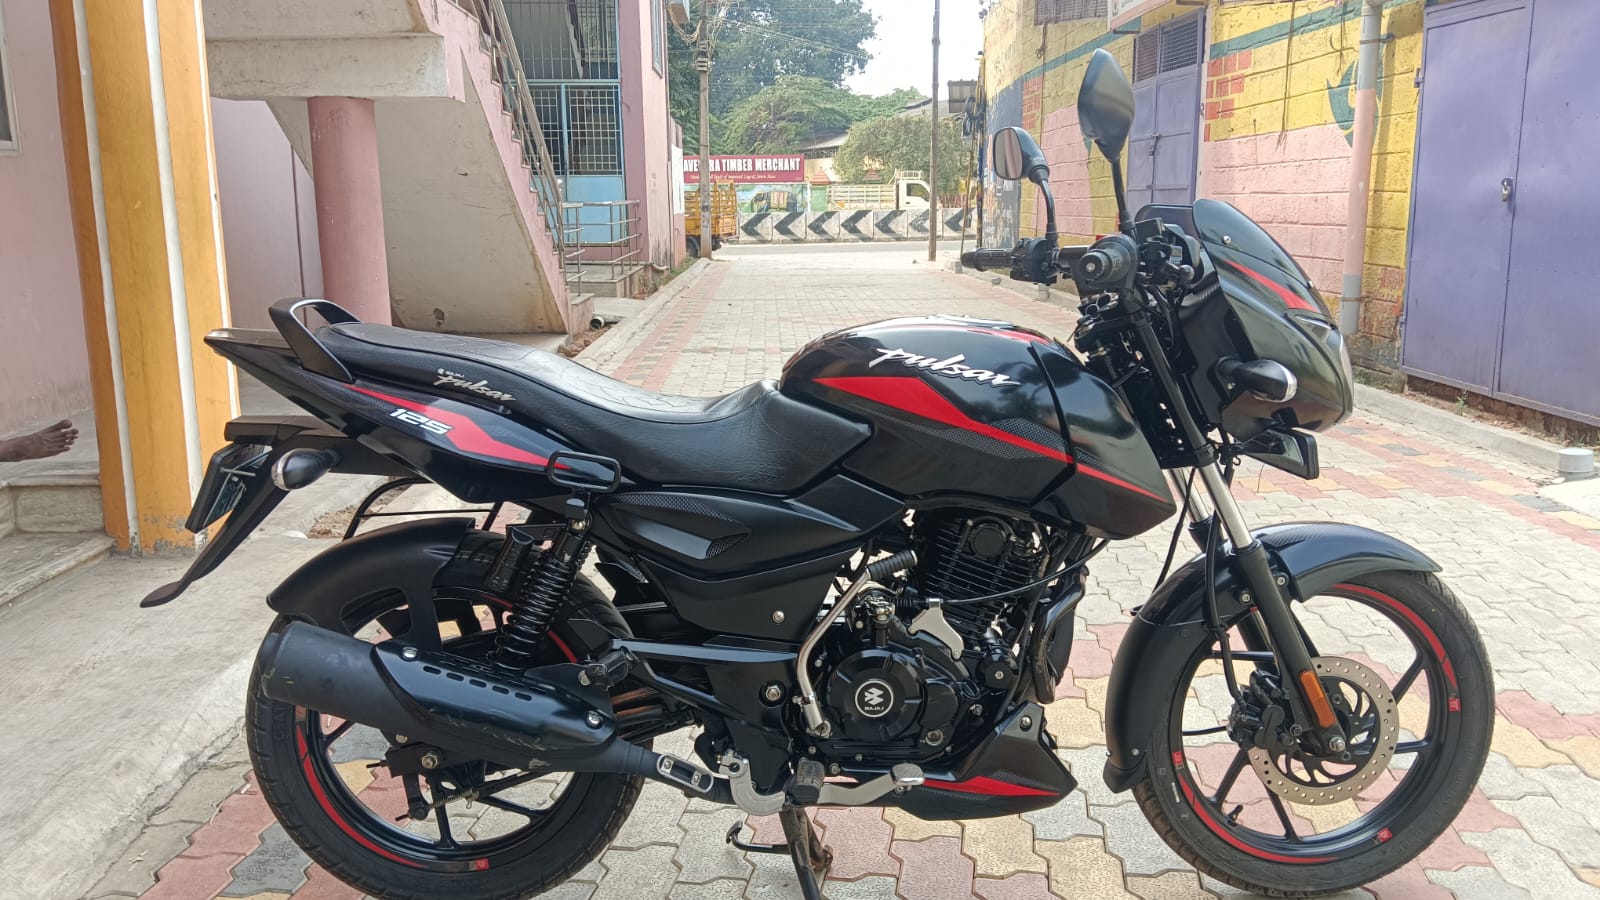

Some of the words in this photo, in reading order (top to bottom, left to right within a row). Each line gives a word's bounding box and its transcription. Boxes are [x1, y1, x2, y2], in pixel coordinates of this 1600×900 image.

[722, 158, 753, 171] TIMBER
[755, 157, 801, 171] MERCHANT
[389, 408, 454, 435] 125
